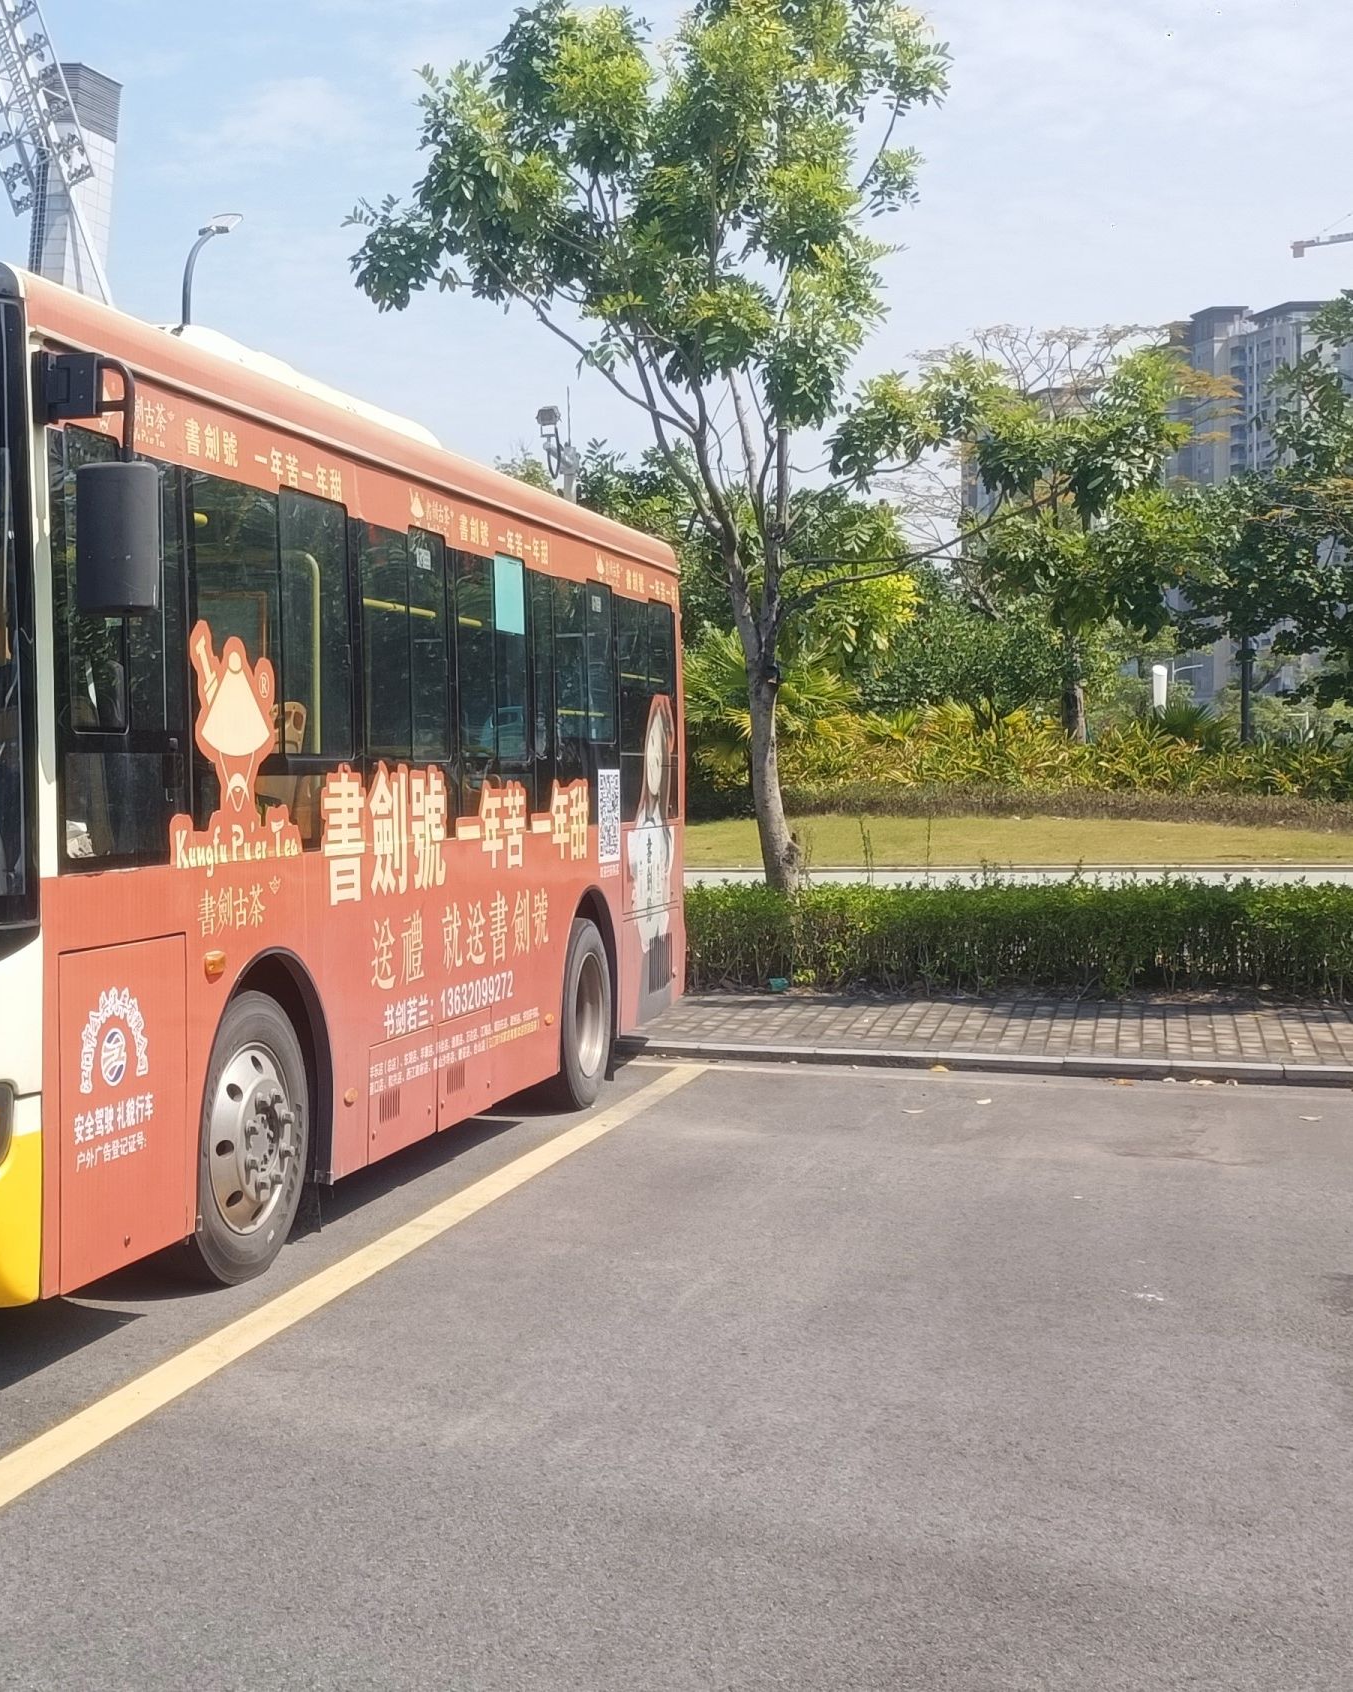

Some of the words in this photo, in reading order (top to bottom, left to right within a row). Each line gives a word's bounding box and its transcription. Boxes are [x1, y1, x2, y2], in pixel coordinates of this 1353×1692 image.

[185, 418, 238, 468] 書劍號
[254, 446, 342, 501] 一年苦一年甜
[175, 825, 228, 878] Kungfu
[230, 820, 268, 862] Pu'er
[270, 818, 299, 858] Tea
[323, 771, 446, 906] 書劍號
[197, 882, 266, 938] 書劍古茶
[440, 970, 514, 1020] 13632099272
[74, 1103, 114, 1145] 安全驾驶
[116, 1091, 154, 1132] 礼貌行车
